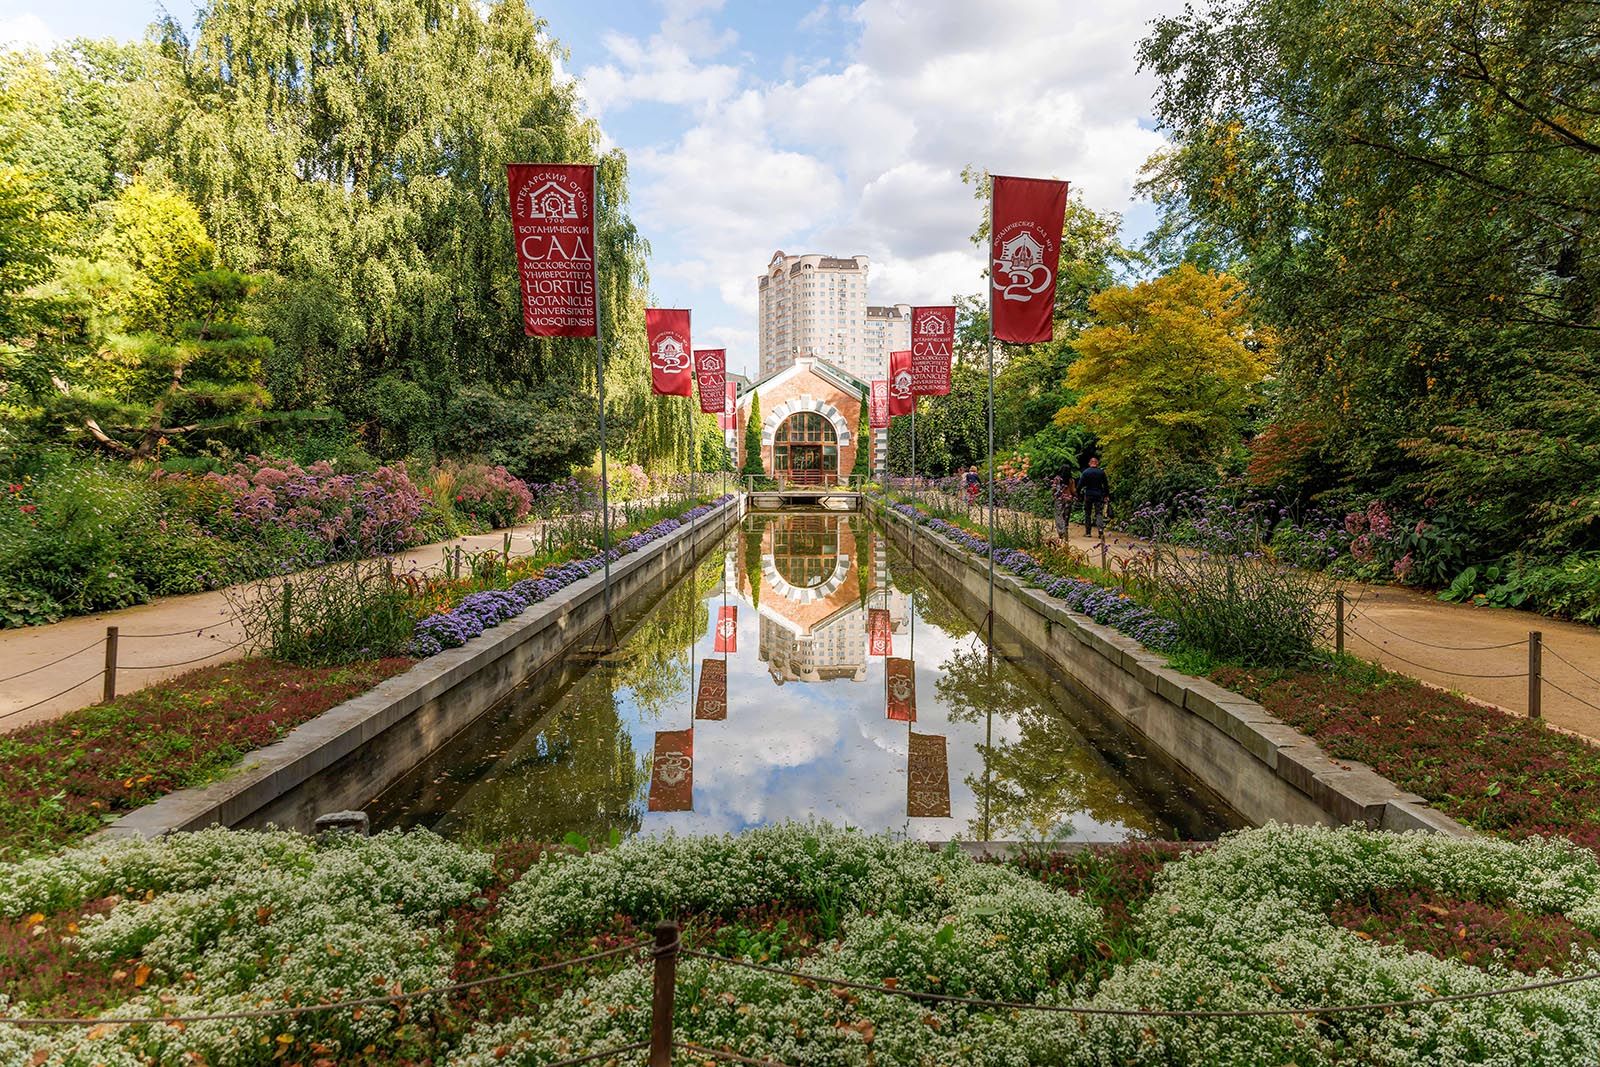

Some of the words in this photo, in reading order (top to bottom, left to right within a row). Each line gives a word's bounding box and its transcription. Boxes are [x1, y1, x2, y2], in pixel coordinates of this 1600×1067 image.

[516, 172, 567, 218] АПТЕКАРСКИЙ
[569, 181, 588, 218] ОГОРОД
[519, 225, 590, 235] БОТАНИЧЕСКИЙ
[521, 235, 591, 261] САД
[523, 261, 592, 271] МОСКОВСКОГО
[524, 270, 592, 279] УНИВЕРСИТЕТА
[526, 279, 593, 295] HORTUS
[527, 295, 594, 307] BOTANICUS
[529, 306, 594, 316] UNIVERSITATIS
[529, 317, 595, 327] MOSQUENSIS
[913, 342, 949, 356] САД
[911, 365, 948, 373] HORTUS
